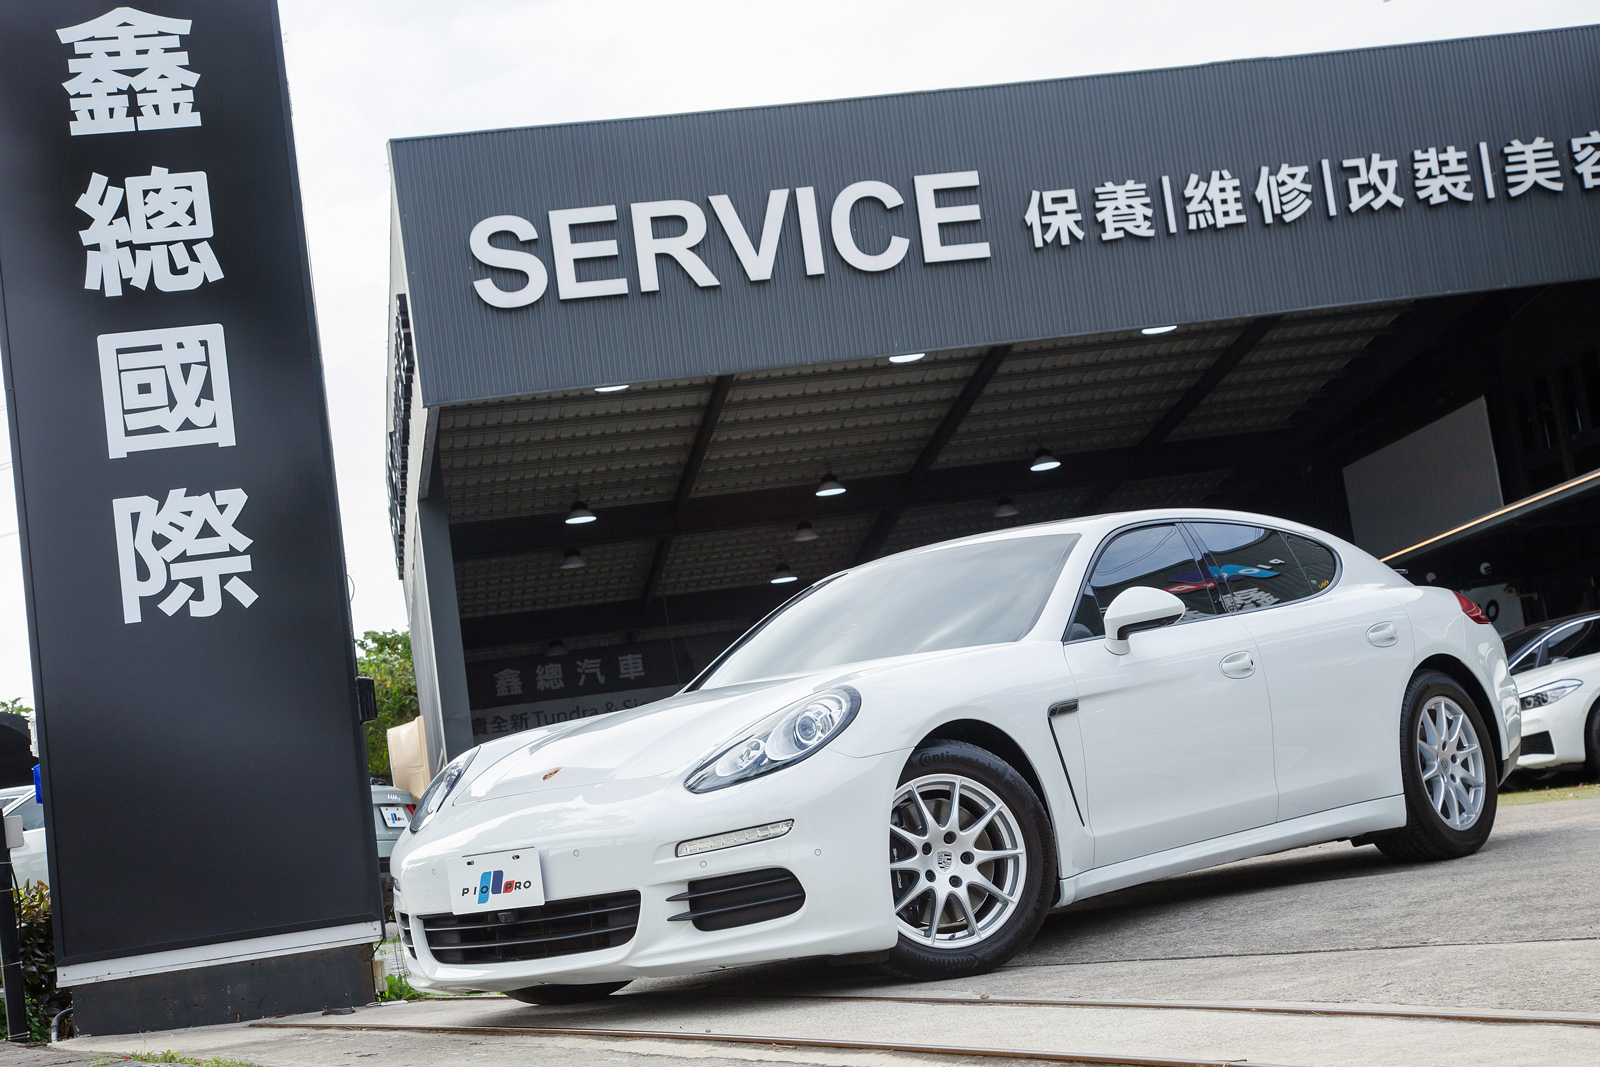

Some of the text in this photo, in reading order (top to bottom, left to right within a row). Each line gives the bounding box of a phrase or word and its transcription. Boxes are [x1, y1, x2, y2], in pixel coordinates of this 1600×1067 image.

[469, 170, 991, 308] SERVICE
[56, 7, 259, 623] 鑫總國際
[494, 653, 645, 697] 鑫總汽車
